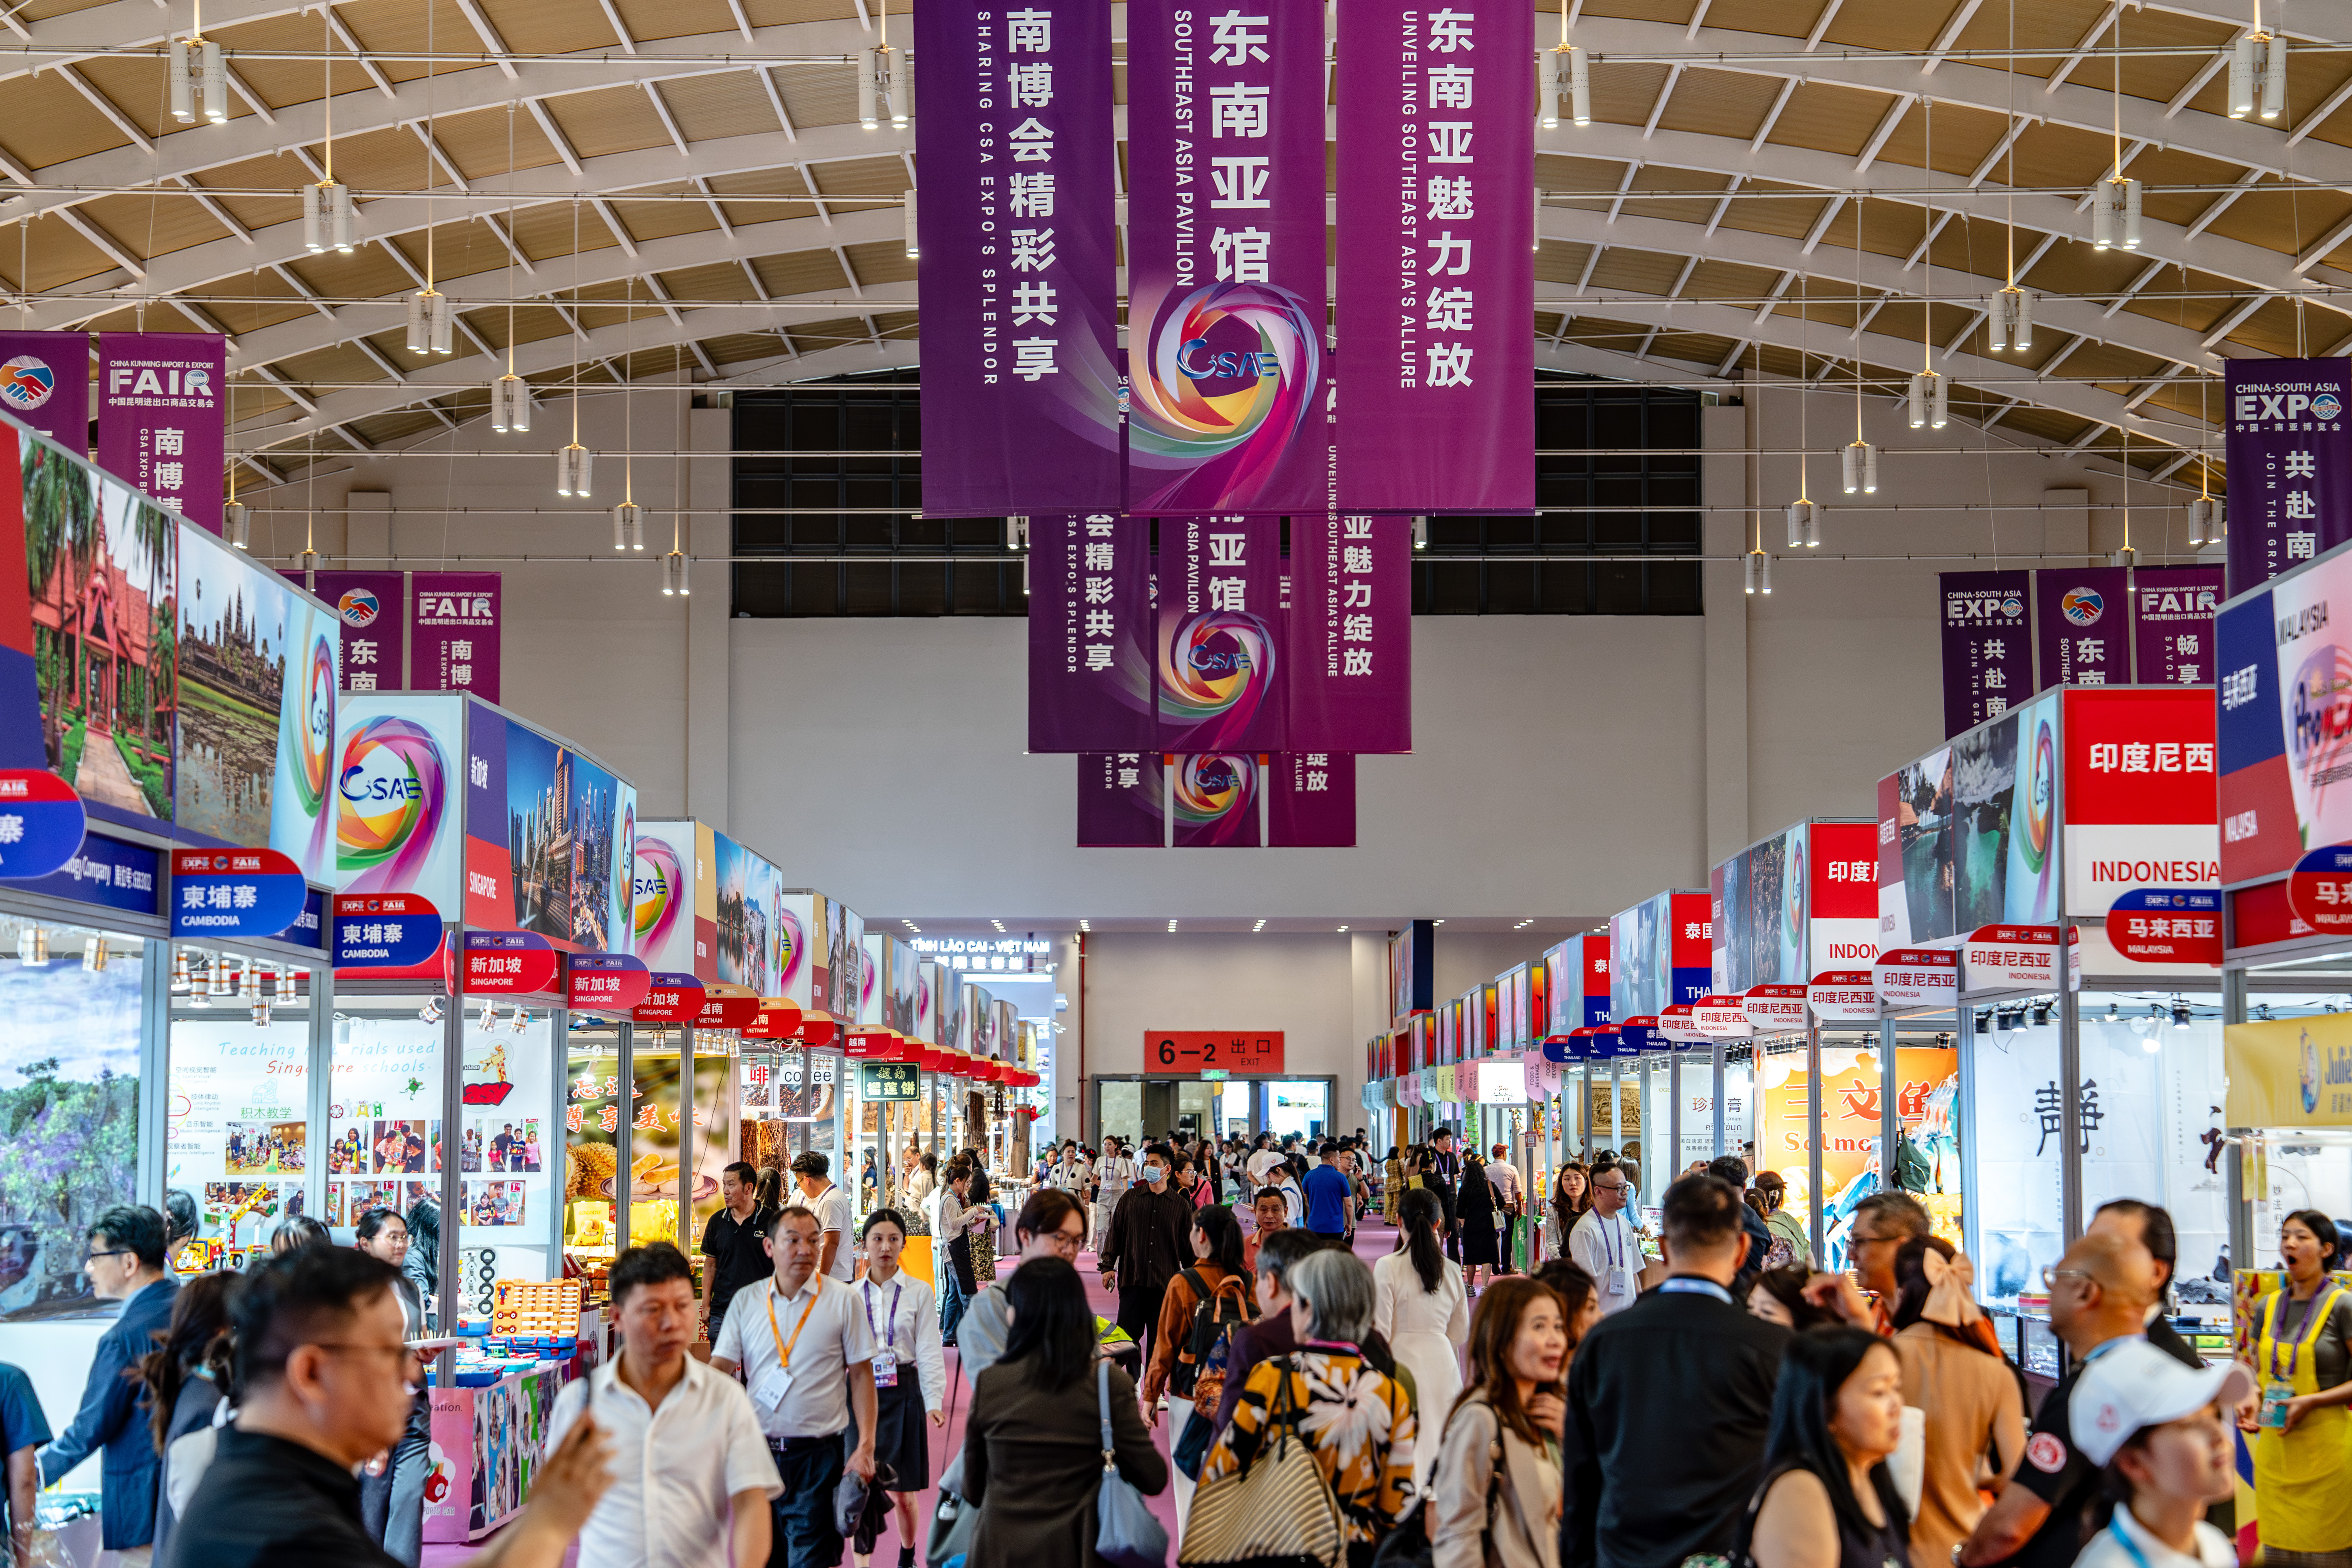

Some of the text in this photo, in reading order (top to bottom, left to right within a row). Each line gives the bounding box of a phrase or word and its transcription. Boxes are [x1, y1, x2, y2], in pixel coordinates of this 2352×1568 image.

[1174, 10, 1194, 286] SOUTHEAST ASIA PAVILION
[1208, 9, 1272, 284] 东南亚馆
[978, 11, 998, 384] SHARING CSA EXPO'S SPLENDOR
[1006, 7, 1059, 381] 南博会精彩共享
[1401, 11, 1417, 388] UNVEILING SOUTHEAST ASIA'S ALLURE
[1426, 8, 1475, 388] 东南亚魅力绽放
[110, 369, 213, 396] FAIR
[2235, 383, 2341, 394] CHINA-SOUTH ASIA
[109, 397, 214, 408] 中国昆明进出口商品交易会
[2235, 394, 2342, 420] EXPO
[2235, 422, 2341, 433] 中国-南亚博览会
[139, 428, 148, 478] CSA EXPO
[2266, 452, 2276, 528] JOIN THE
[2285, 450, 2316, 559] 共赴南
[1187, 522, 1199, 613] ASIA PAVILION
[1209, 515, 1246, 612] 亚馆
[1328, 446, 1338, 677] UNVEILING SOUTHEAST ASIA'S ALLURE
[1085, 515, 1114, 672] 会精彩共享
[1343, 516, 1373, 676] 亚魅力绽放
[1948, 590, 2002, 599] CHINA-SOUTH
[2142, 592, 2217, 612] FAIR
[419, 598, 493, 617] FAIR
[1067, 545, 1077, 672] EXPO'S SPLENDOR
[1948, 598, 2023, 618] EXPO
[1948, 619, 2023, 627] 中国-南亚博览会
[350, 639, 378, 690] 东南
[451, 639, 472, 685] 南博
[2076, 637, 2106, 684] 东南
[2165, 636, 2174, 680] SAVOR
[2177, 634, 2200, 684] 畅享
[1984, 639, 2007, 718] 共赴南
[2089, 742, 2214, 773] 印度尼西
[471, 754, 488, 790] 新加坡
[2092, 861, 2219, 882] INDONESIA
[470, 871, 496, 899] SINGAPORE
[182, 885, 257, 909] 柬埔寨
[181, 915, 240, 926] CAMBODIA
[2127, 918, 2215, 938] 马来西亚
[342, 923, 403, 944] 柬埔寨
[342, 948, 389, 959] CAMBODIA
[967, 941, 988, 952] CAI
[1023, 941, 1050, 953] NAM
[2127, 945, 2174, 954] MALAYSIA
[471, 957, 522, 973] 新加坡
[1971, 950, 2051, 968] 印度尼西亚
[575, 976, 620, 992] 新加坡
[1883, 971, 1956, 988] 印度尼西亚
[2009, 972, 2051, 981] INDONESIA
[640, 992, 680, 1006] 新加坡
[1813, 991, 1876, 1004] 印度尼西亚
[1881, 990, 1921, 1000] INDONESIA
[700, 1003, 723, 1014] 越南
[1747, 1003, 1803, 1014] 印度尼西亚
[848, 1037, 866, 1046] 越南
[1646, 1029, 1665, 1039] 泰国
[218, 1040, 436, 1059] Teaching used
[1231, 1038, 1270, 1054] 出口
[266, 1060, 353, 1077] Singore
[1241, 1057, 1260, 1066] EXIT
[750, 1066, 769, 1085] 啡
[785, 1071, 832, 1082] coee
[876, 1066, 906, 1080] 越南
[867, 1081, 915, 1095] 榴莲饼
[241, 1107, 292, 1118] 积木教学
